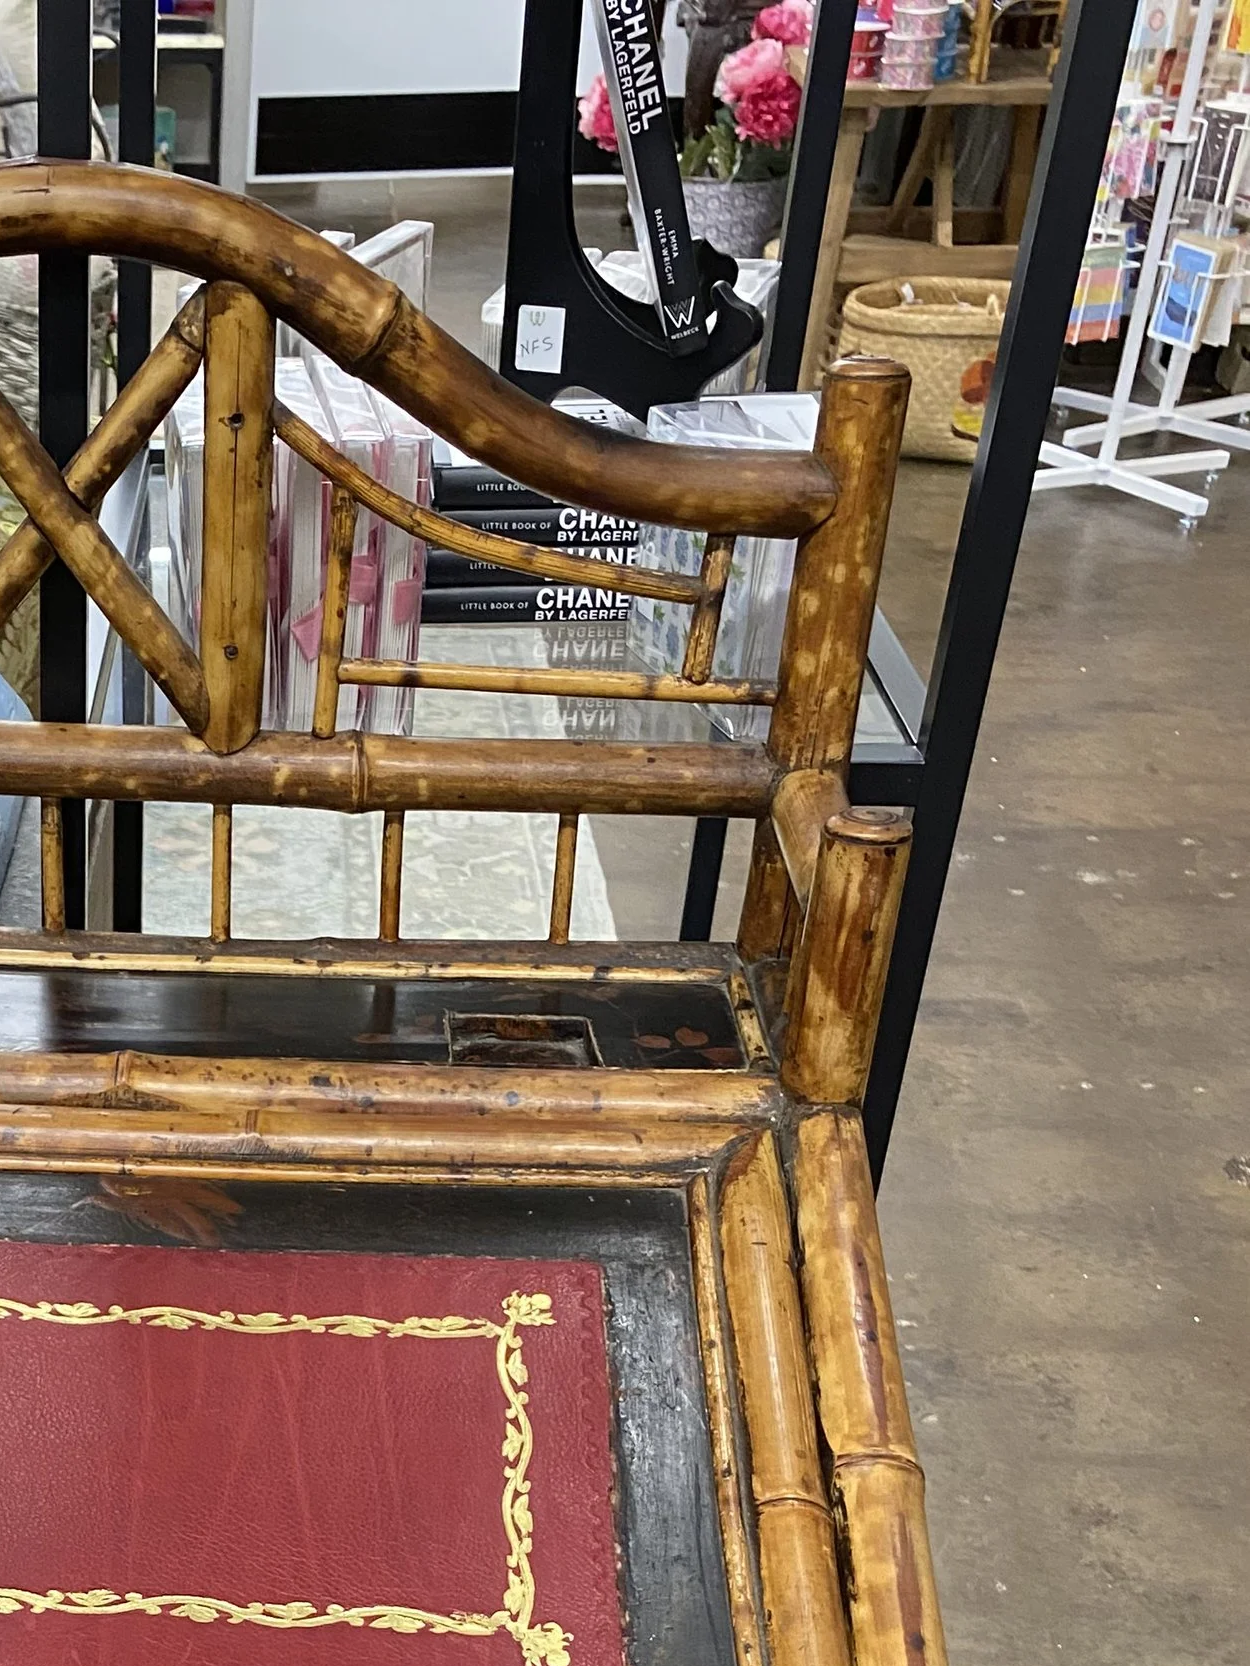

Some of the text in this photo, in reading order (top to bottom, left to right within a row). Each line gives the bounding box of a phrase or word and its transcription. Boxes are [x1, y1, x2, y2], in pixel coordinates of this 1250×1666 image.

[605, 0, 641, 135] BY LAGERFELD
[620, 0, 663, 131] CHANEL
[654, 208, 675, 285] BAXTER-WRIGHT
[668, 229, 679, 258] EMMA
[520, 336, 554, 357] NFS
[477, 483, 527, 492] LITTLE BOO
[481, 522, 508, 530] LITTLE
[512, 522, 537, 530] BOOK
[539, 522, 551, 530] OF
[557, 531, 639, 541] BY LAGERF
[461, 602, 487, 610] LITTLE
[490, 602, 515, 610] BOOK
[536, 587, 630, 609] CHANE
[534, 610, 628, 620] BY LAGERFE
